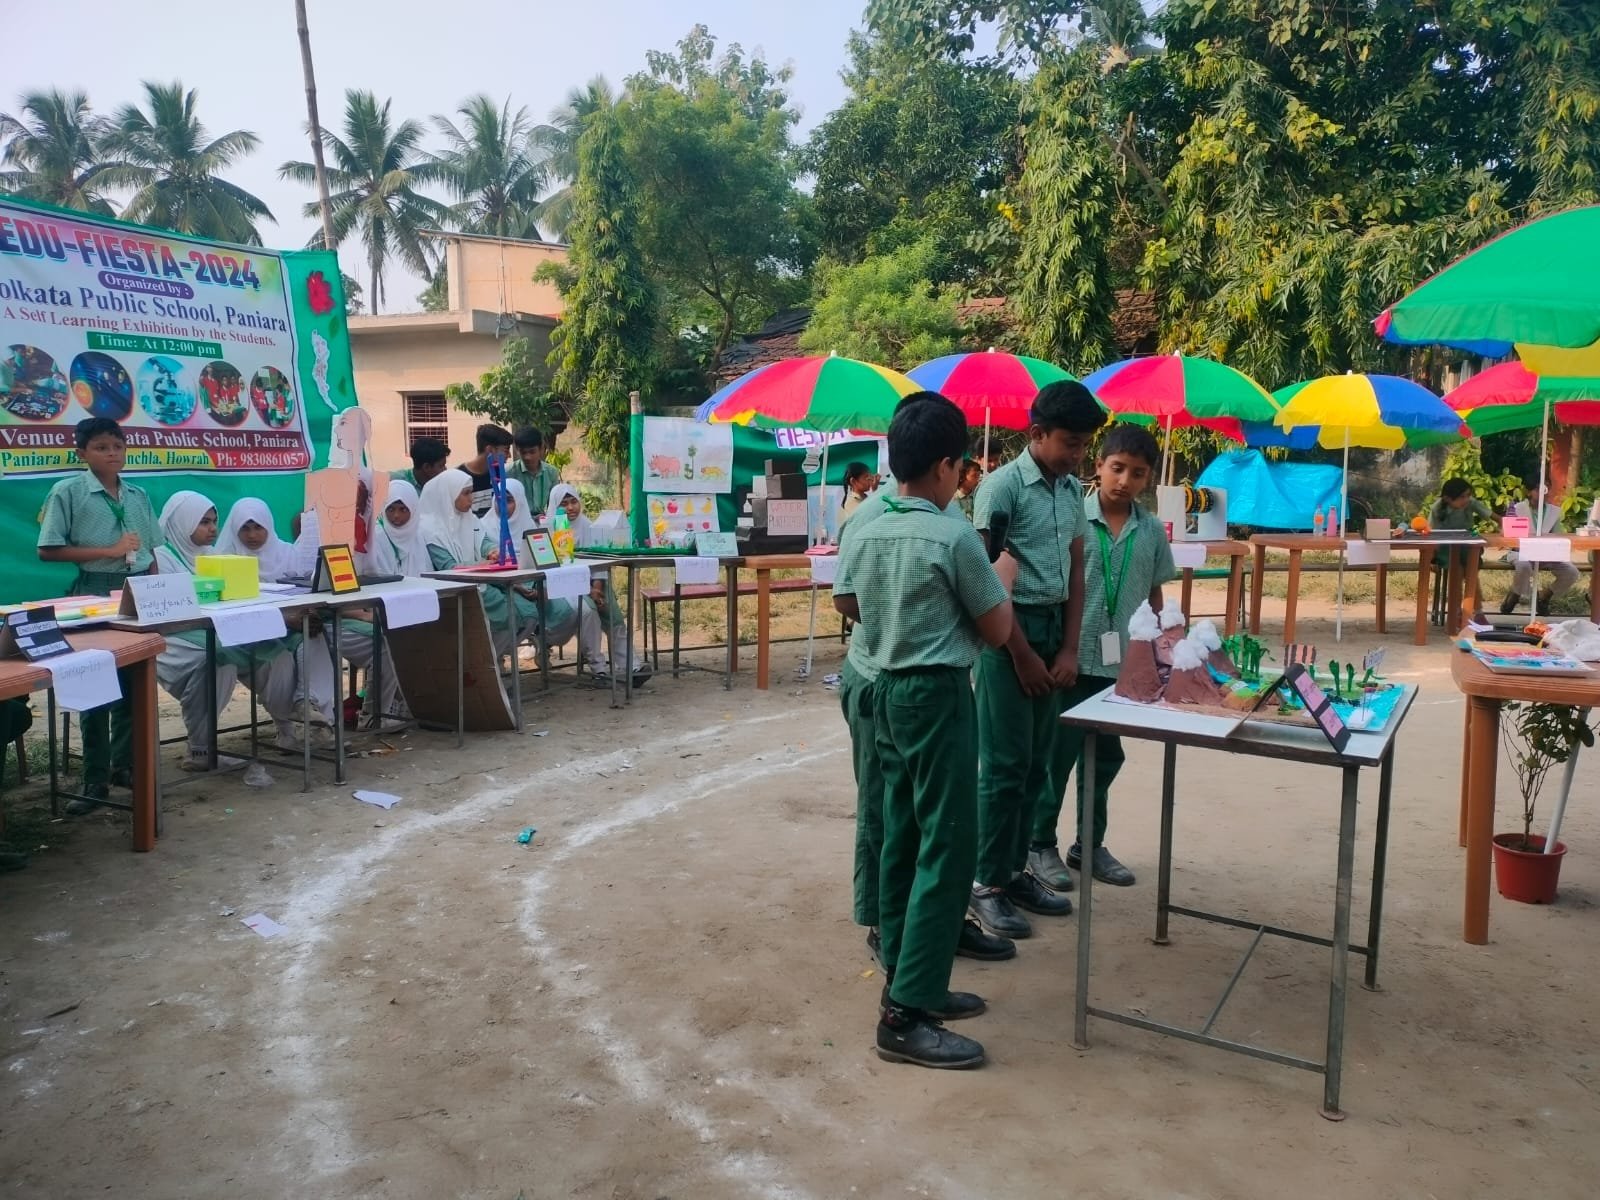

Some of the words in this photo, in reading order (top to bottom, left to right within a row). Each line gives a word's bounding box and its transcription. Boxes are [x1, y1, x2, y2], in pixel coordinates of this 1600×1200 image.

[0, 216, 260, 289] EDU-FIESTA-2024
[104, 273, 166, 293] Organized
[167, 282, 181, 297] by
[0, 278, 72, 306] olkata
[78, 286, 148, 315] Public
[152, 297, 222, 327] School,
[224, 305, 287, 333] Paniara
[4, 306, 16, 320] A
[19, 307, 47, 323] Self
[50, 310, 119, 333] Learning
[123, 316, 189, 338] Exhibition
[191, 325, 206, 341] by
[209, 329, 227, 341] the
[229, 330, 276, 346] Students.
[96, 333, 138, 348] Time:
[141, 338, 158, 350] At
[162, 340, 195, 353] 12:00
[197, 343, 217, 356] pm
[0, 427, 66, 446] Venue
[153, 430, 199, 448] Public
[202, 432, 251, 450] School,
[254, 433, 299, 448] Paniara
[1, 451, 61, 467] Paniara
[166, 452, 209, 465] Howrah
[217, 452, 237, 466] Ph:
[240, 452, 304, 467] 9830861057
